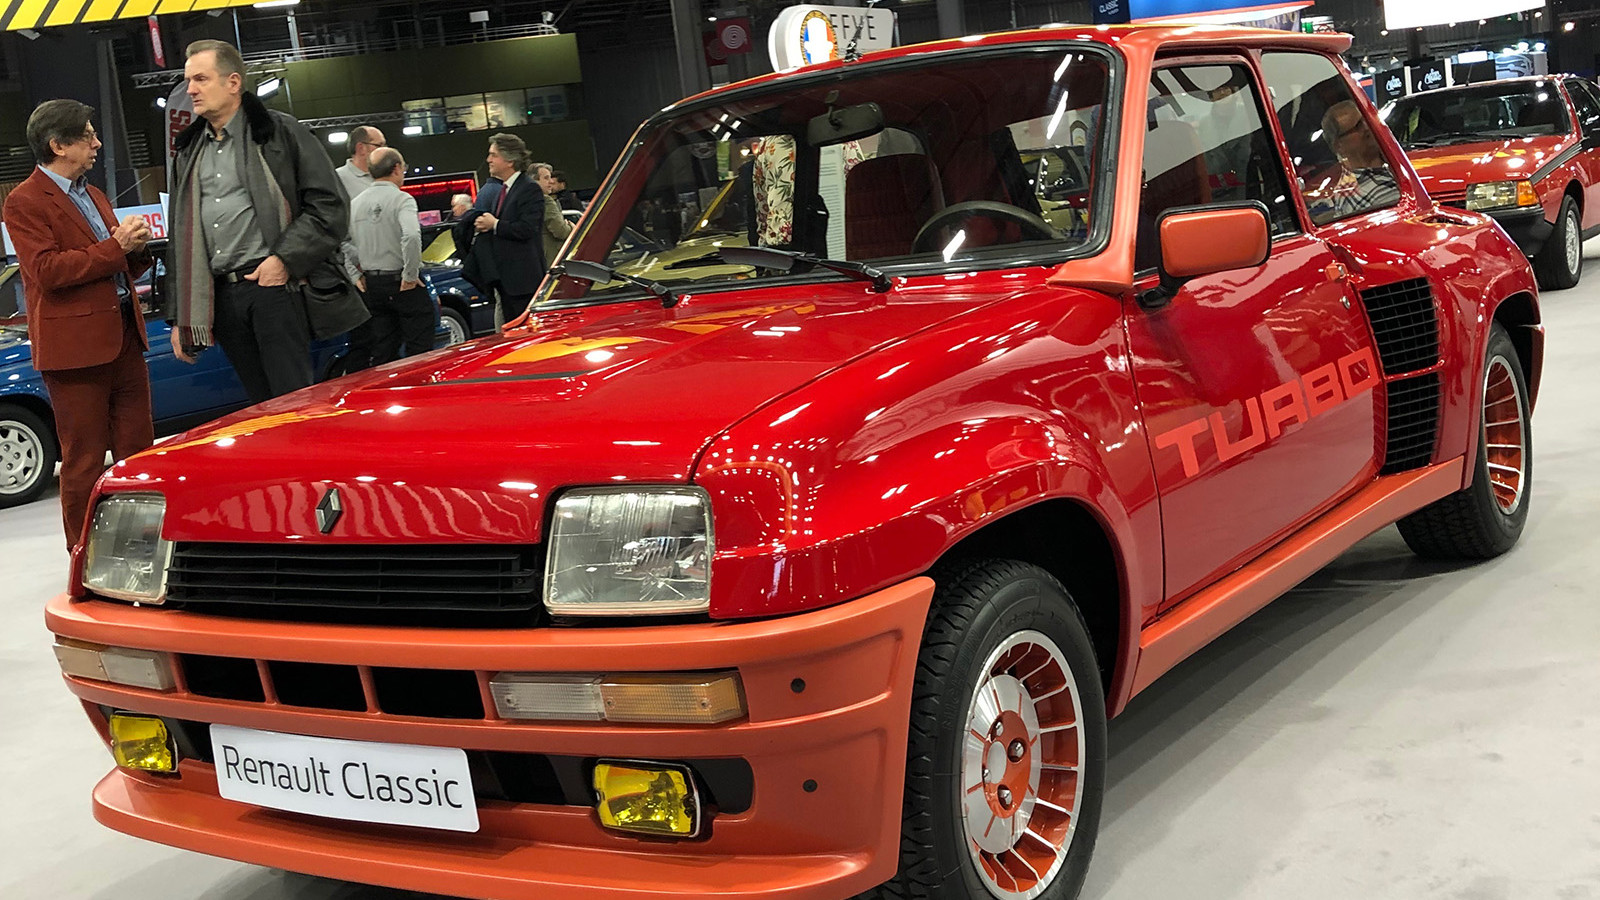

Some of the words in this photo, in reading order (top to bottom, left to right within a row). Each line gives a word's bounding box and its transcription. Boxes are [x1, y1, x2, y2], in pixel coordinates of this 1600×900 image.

[1154, 346, 1380, 478] TURBO
[222, 744, 335, 797] Renault
[341, 761, 463, 809] Classic
